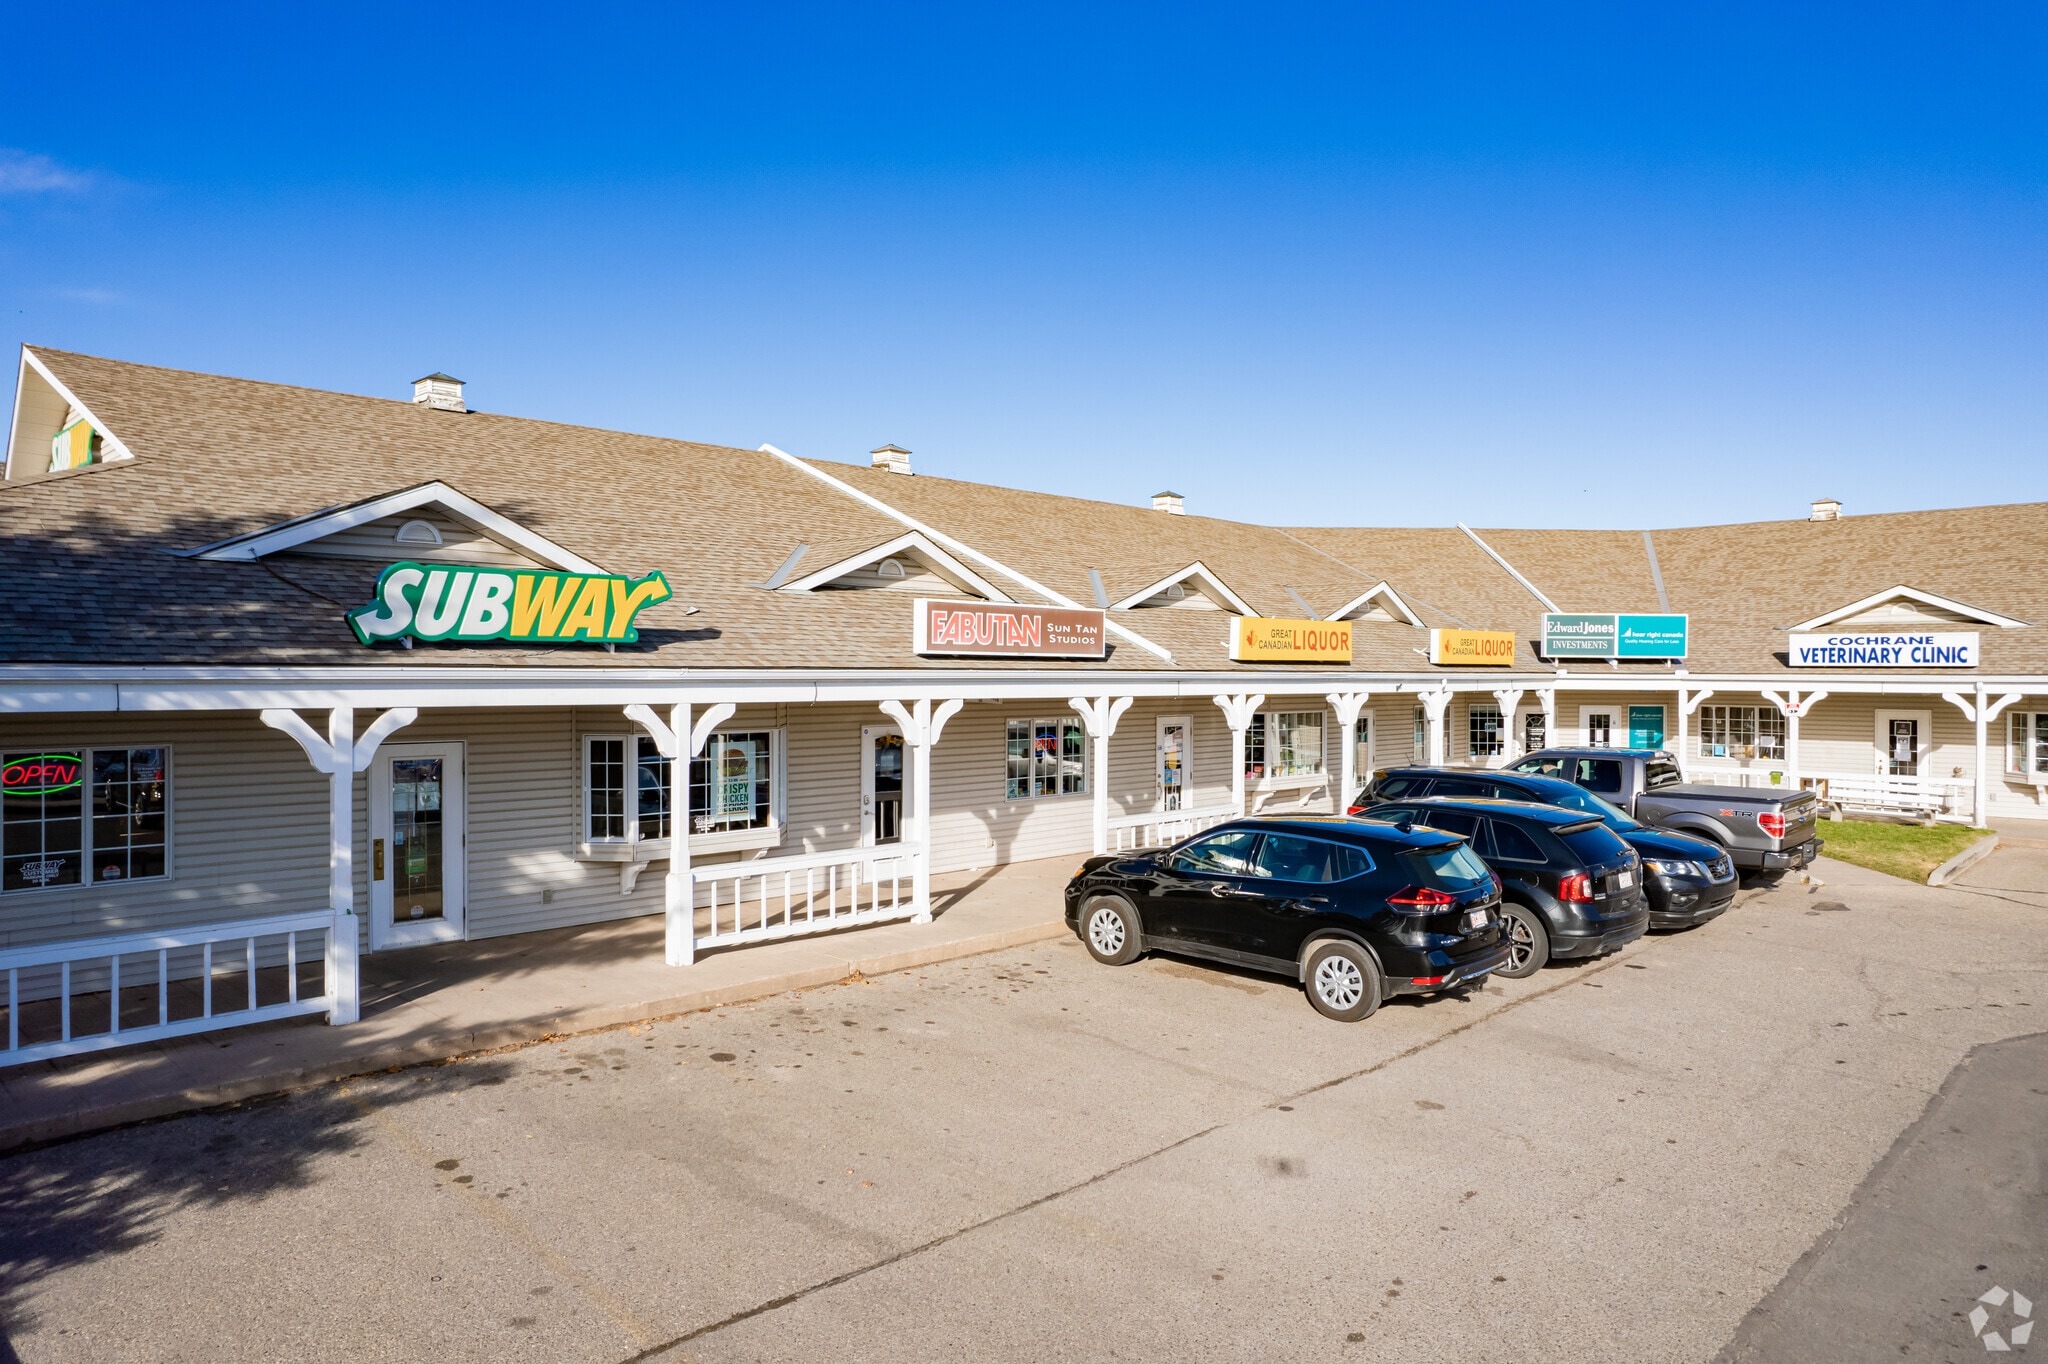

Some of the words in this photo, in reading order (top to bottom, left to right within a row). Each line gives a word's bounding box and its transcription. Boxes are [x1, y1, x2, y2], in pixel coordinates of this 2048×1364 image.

[355, 568, 669, 639] SUBWAY
[931, 610, 1042, 647] FABUTAN
[1270, 629, 1292, 638] GREAT
[1258, 640, 1292, 650] CANADIAN
[1293, 630, 1349, 651] LIQUOR
[1460, 638, 1475, 646] GREAT
[1552, 640, 1608, 649] INVESTMENTS
[1827, 636, 1934, 646] COCHRANE
[1452, 647, 1474, 655] CANADIAN
[1475, 639, 1513, 656] LIQUOR
[1799, 647, 1902, 663] VETERINARY
[1910, 646, 1968, 663] CLINIC
[2, 765, 76, 784] OPEN
